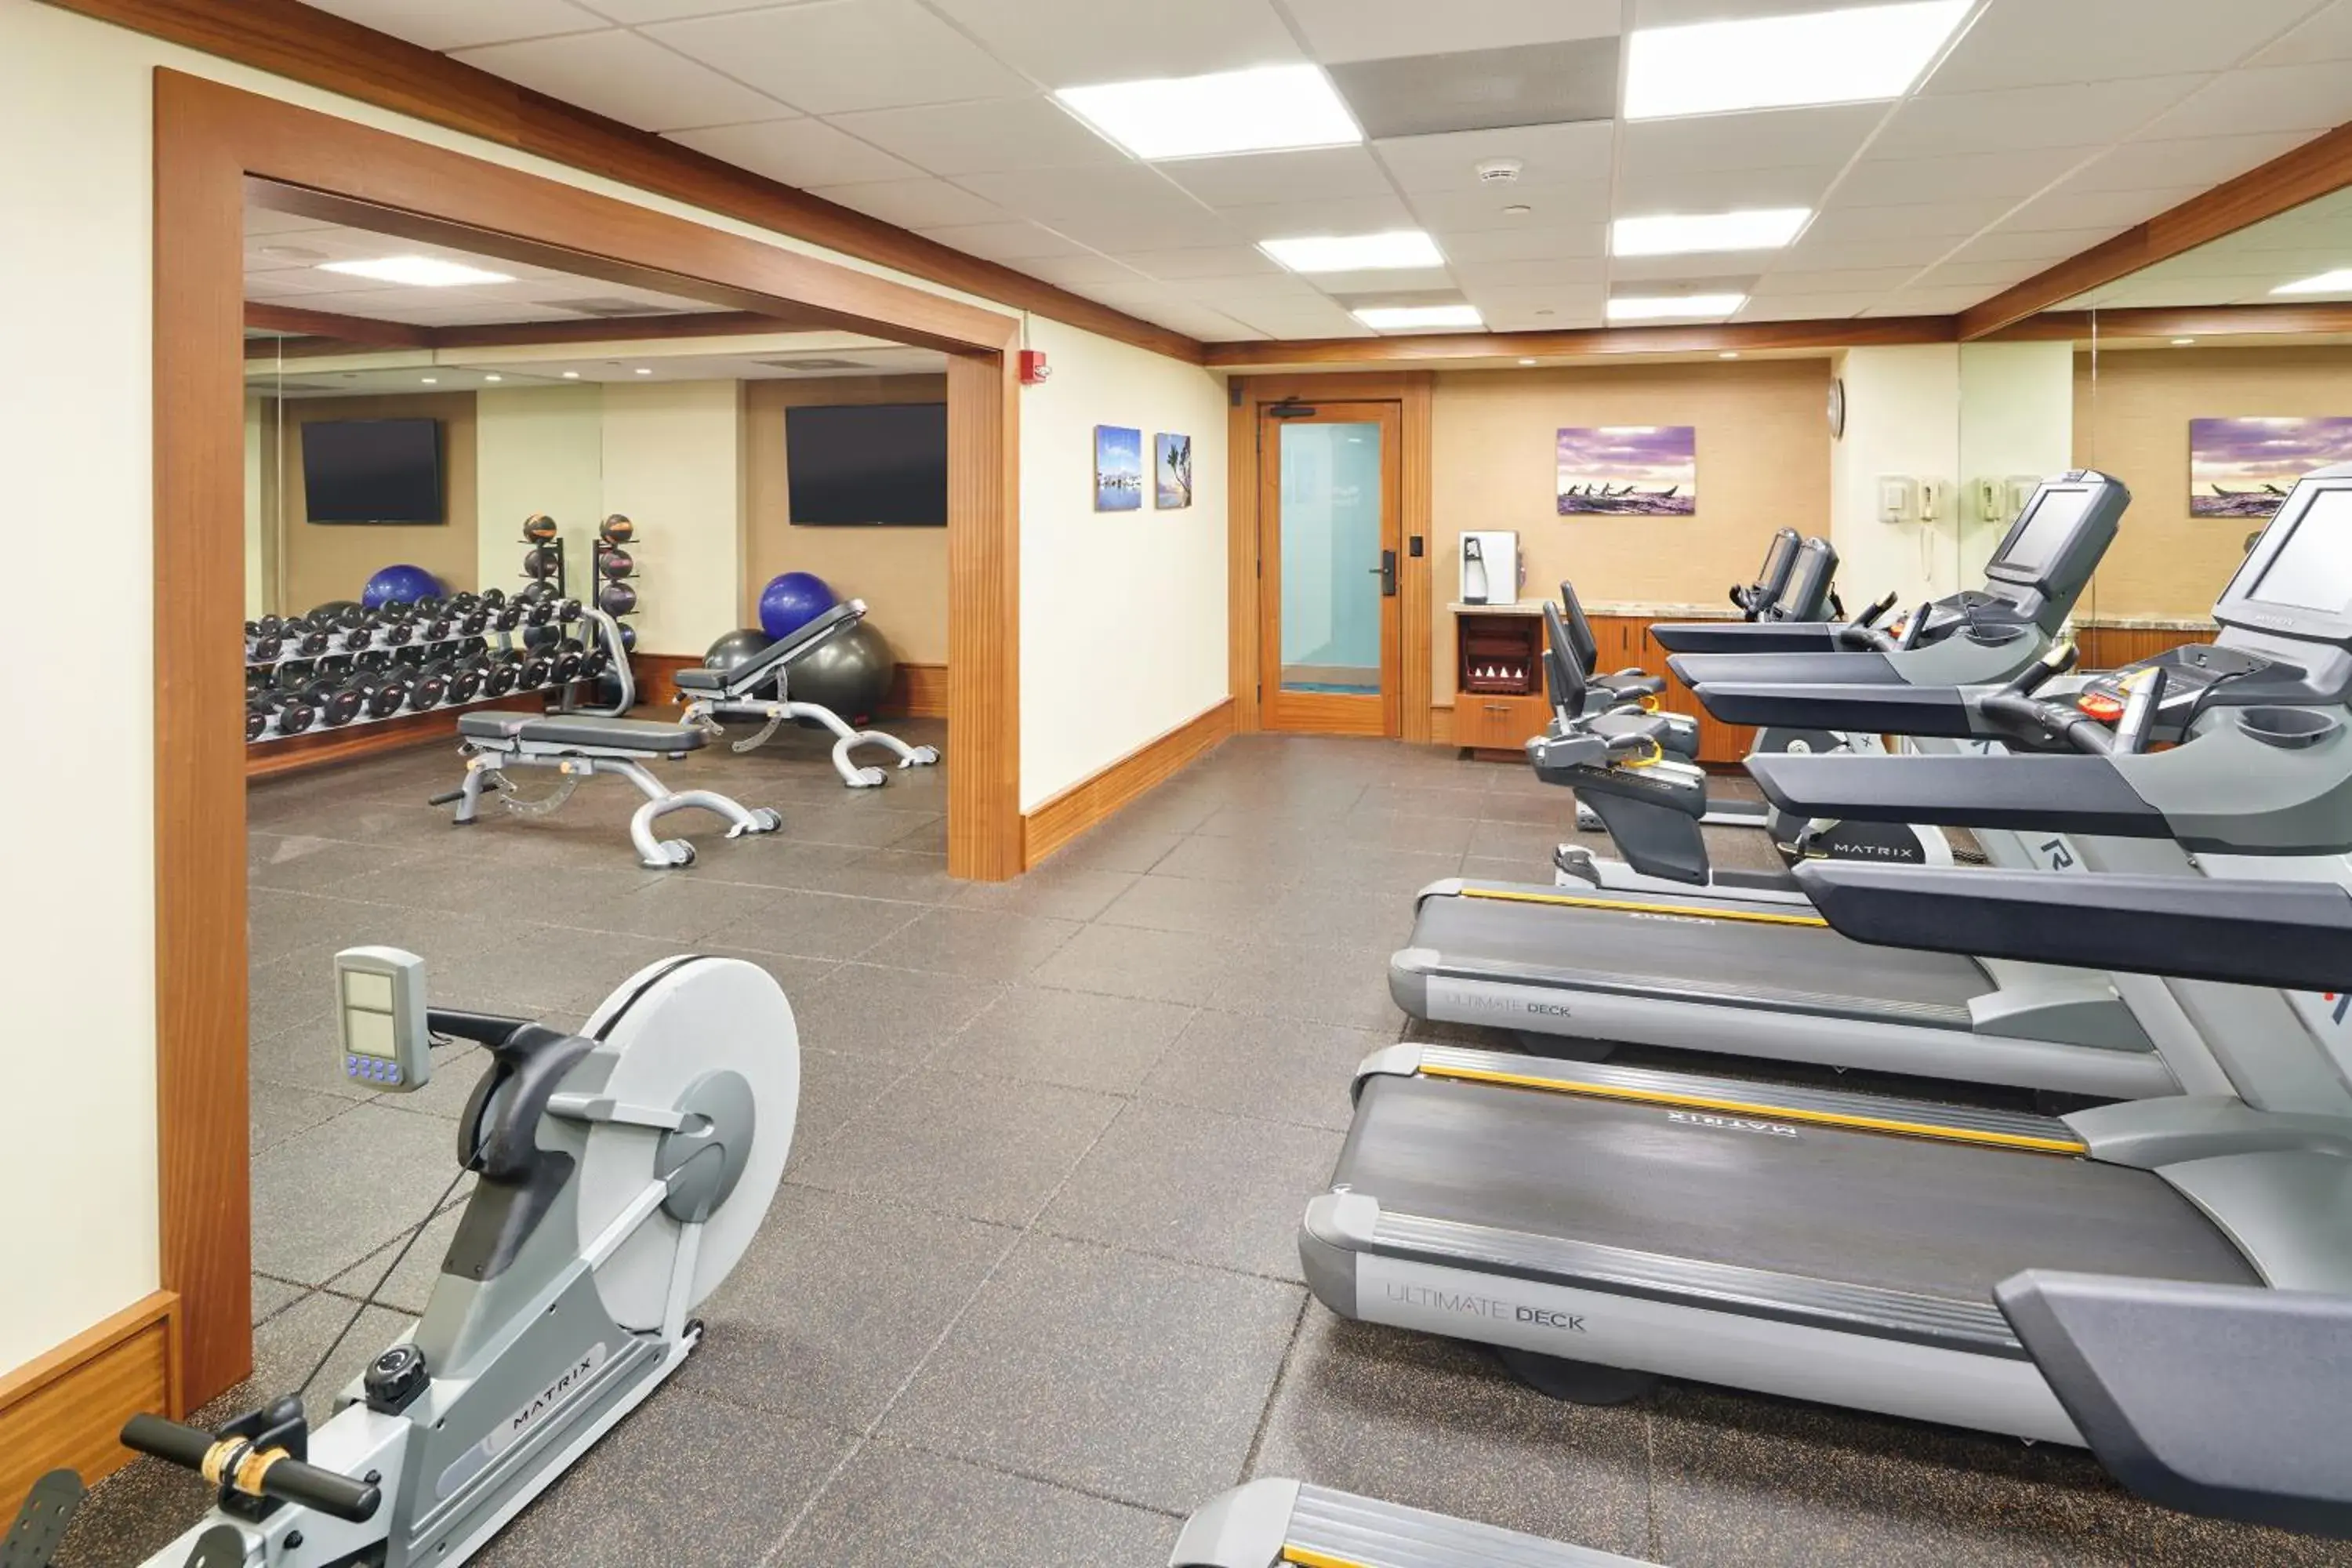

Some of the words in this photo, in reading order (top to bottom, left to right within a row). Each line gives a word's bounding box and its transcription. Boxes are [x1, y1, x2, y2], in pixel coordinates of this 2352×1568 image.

[1834, 844, 1913, 857] MATRIX
[1527, 1002, 1571, 1018] DECK
[1386, 1282, 1509, 1319] ULTIMATE
[1515, 1305, 1587, 1332] DECK
[514, 1357, 590, 1431] MATRIX
